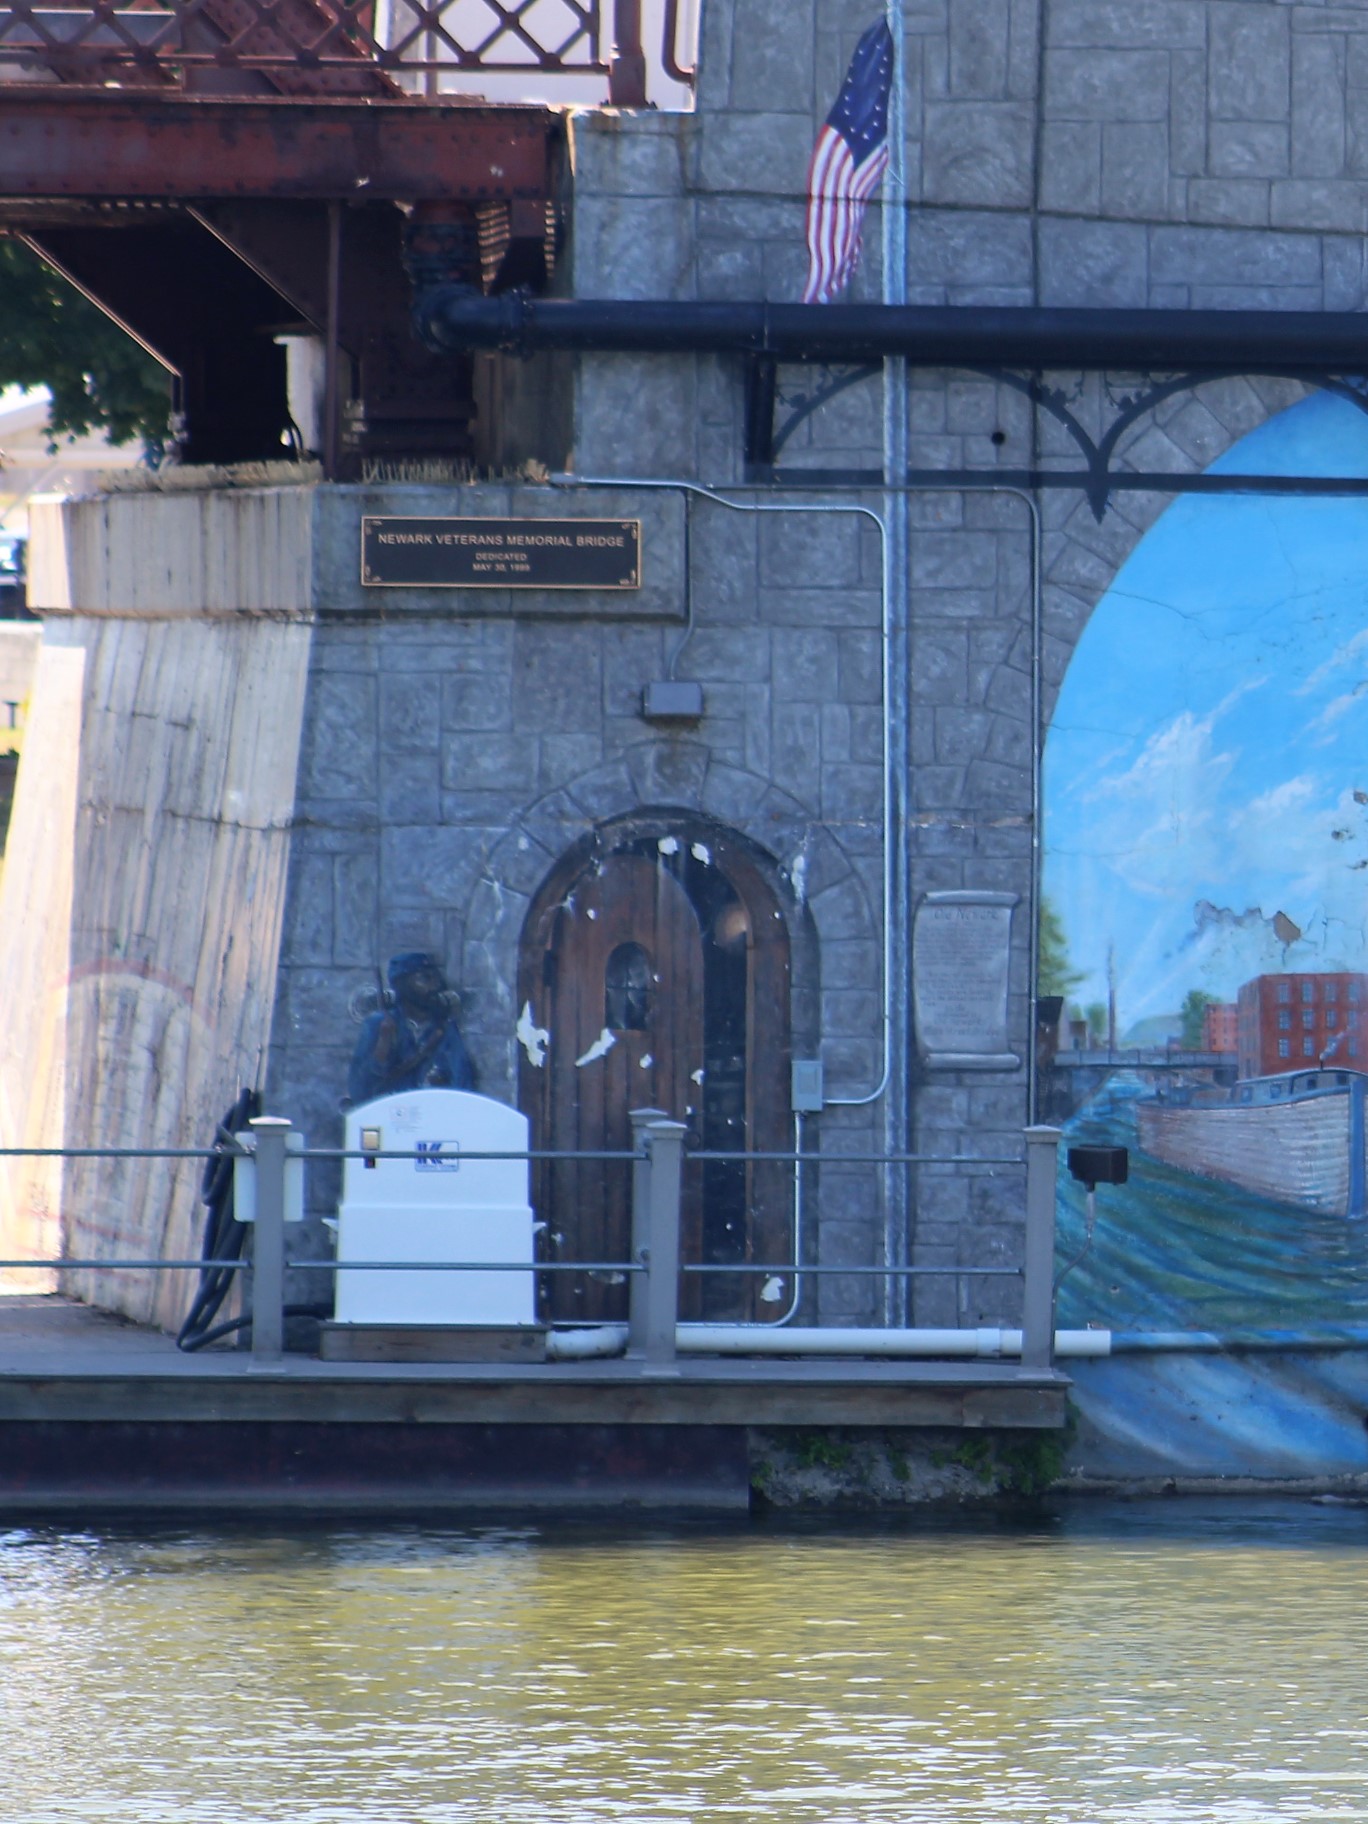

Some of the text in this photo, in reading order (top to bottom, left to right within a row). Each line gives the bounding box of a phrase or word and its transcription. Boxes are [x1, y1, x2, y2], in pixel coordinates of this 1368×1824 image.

[378, 533, 625, 548] NEWARK VETERANS MEMORIAL BRIDGE
[475, 552, 527, 561] DEDICATED
[472, 563, 493, 572] MAY
